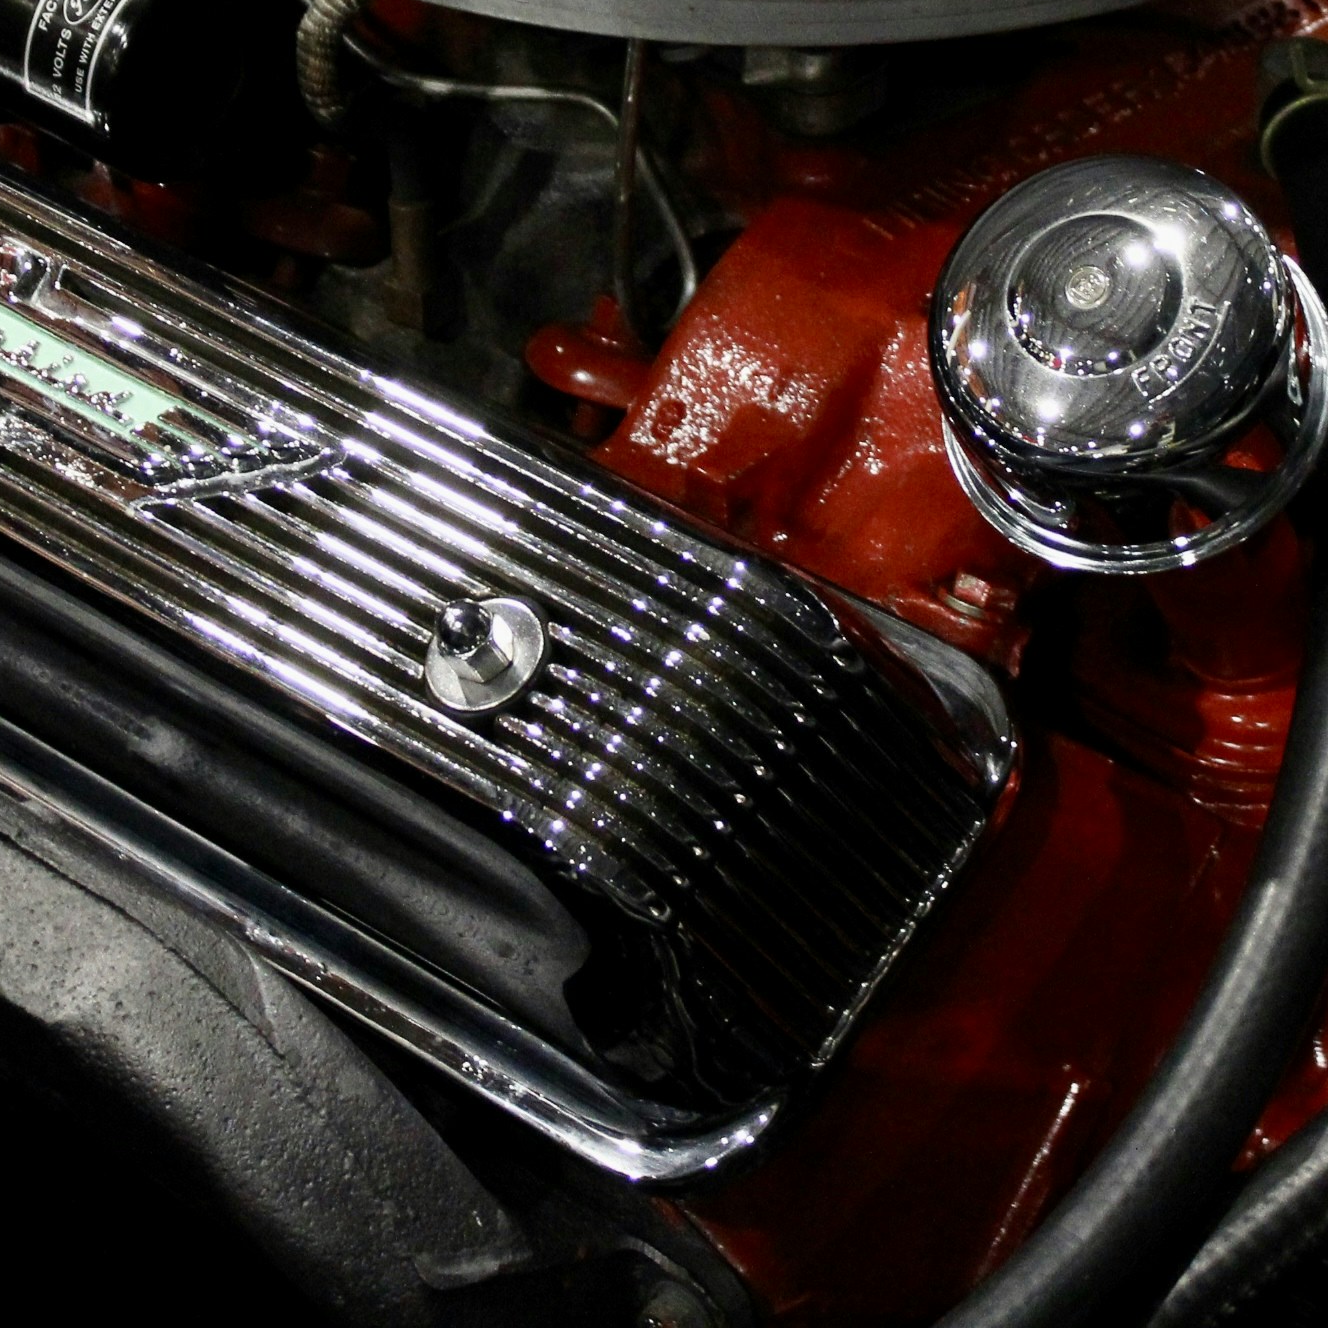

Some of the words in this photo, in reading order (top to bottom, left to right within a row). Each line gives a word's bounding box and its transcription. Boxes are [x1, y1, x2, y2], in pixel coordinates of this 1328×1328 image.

[52, 27, 73, 80] VOLTS
[78, 32, 97, 65] WITH
[74, 67, 86, 94] USE
[1130, 295, 1218, 398] FRONT
